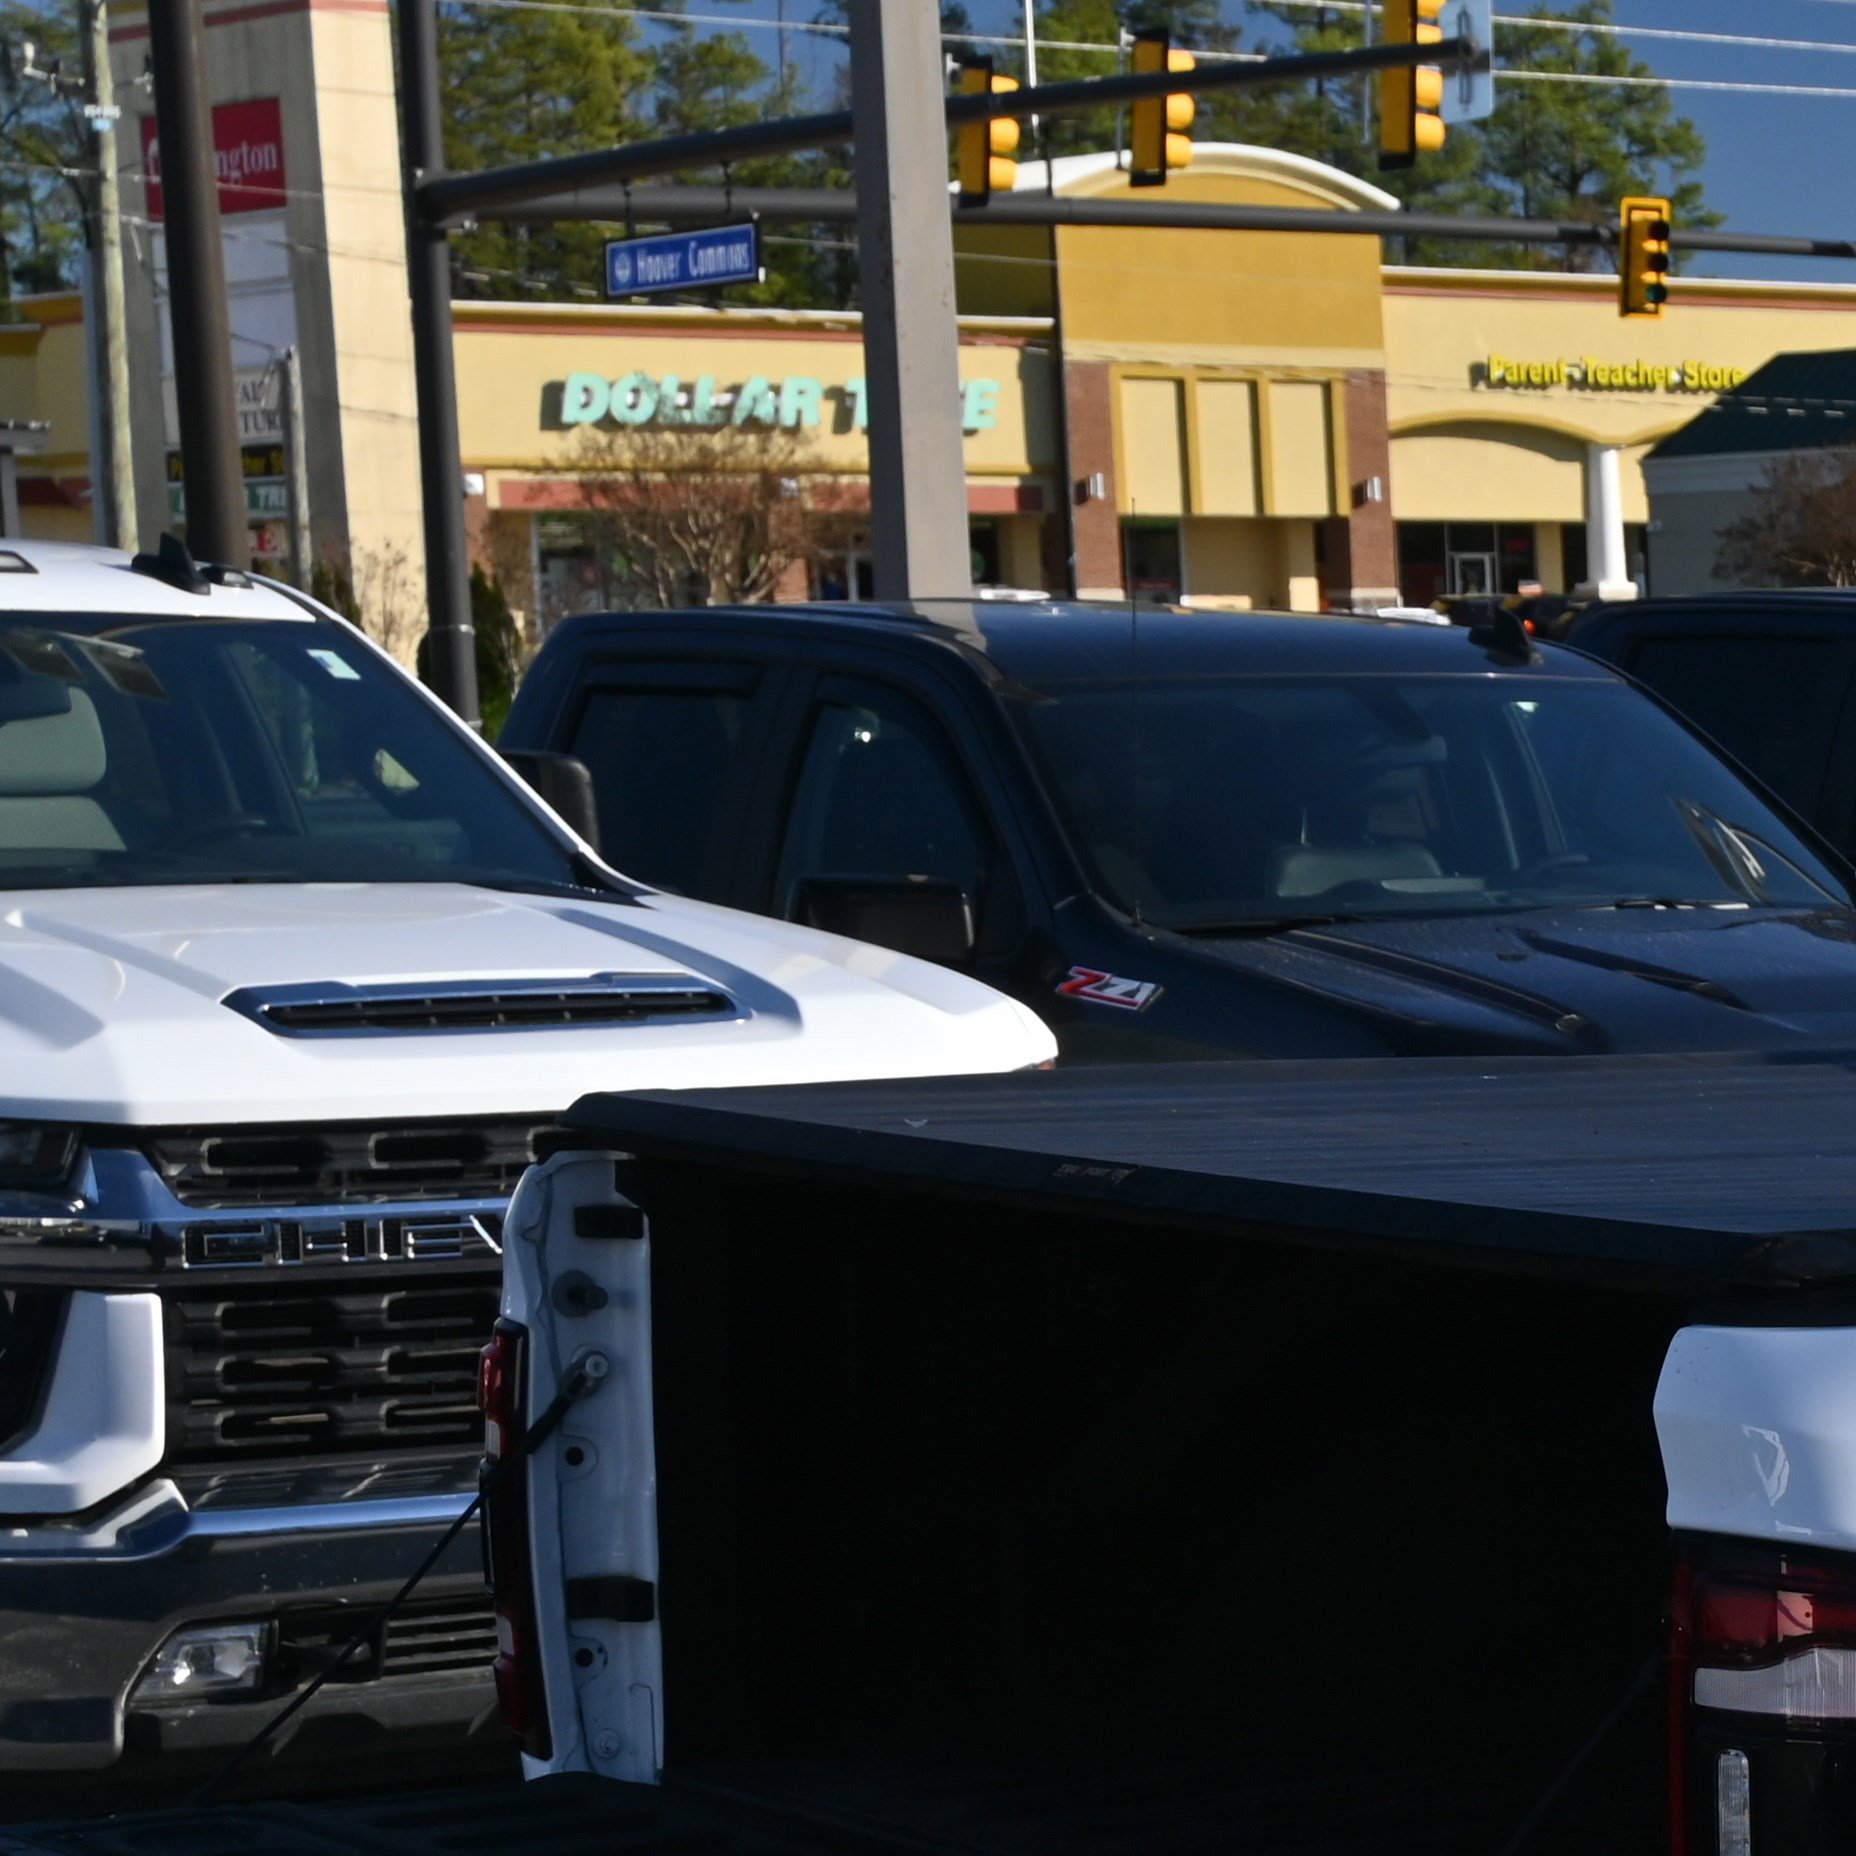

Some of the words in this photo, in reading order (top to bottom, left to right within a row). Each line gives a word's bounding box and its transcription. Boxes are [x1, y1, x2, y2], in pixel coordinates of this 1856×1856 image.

[637, 248, 681, 284] Hoover
[688, 240, 749, 277] Commons
[1584, 355, 1673, 387] Teacher
[1683, 359, 1749, 390] Store
[562, 372, 825, 426] DOLLAR
